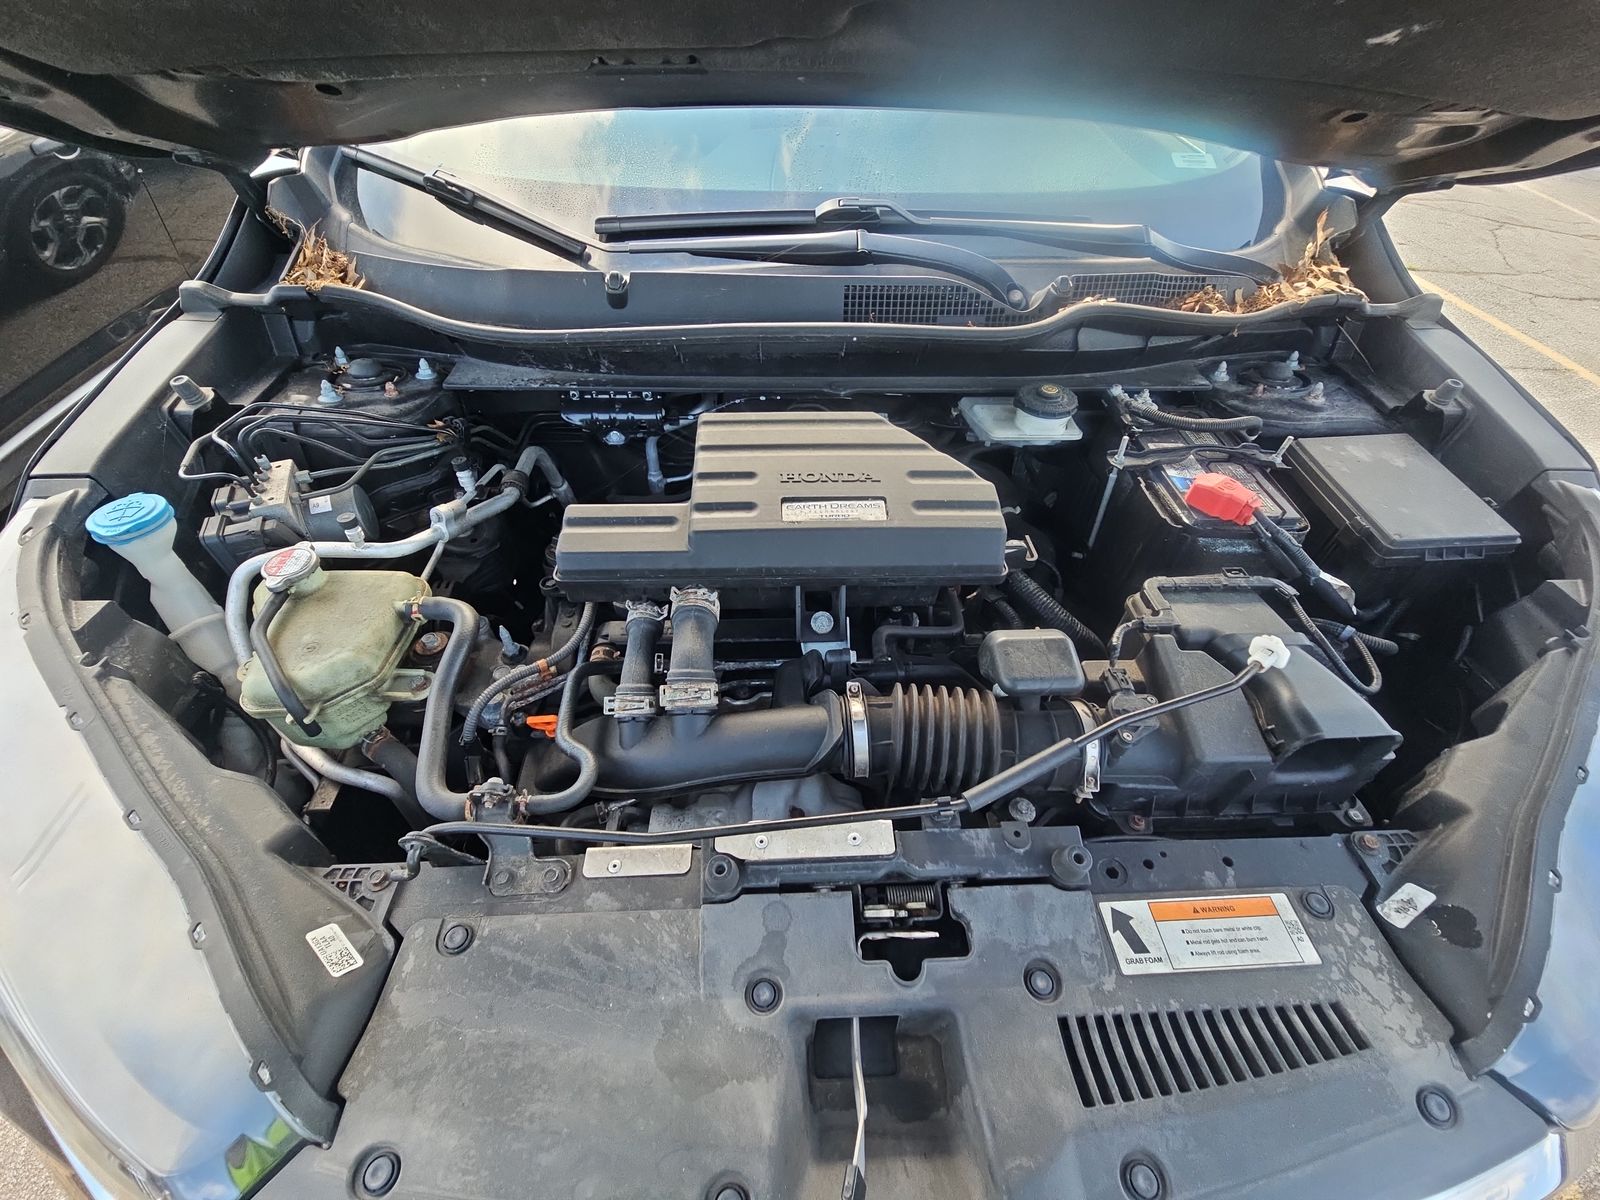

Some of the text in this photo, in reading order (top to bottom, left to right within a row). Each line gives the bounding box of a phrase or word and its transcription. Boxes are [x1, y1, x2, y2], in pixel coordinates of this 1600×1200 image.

[779, 472, 881, 483] HONDA
[1200, 905, 1236, 914] WARNING
[1144, 956, 1163, 964] FOAM
